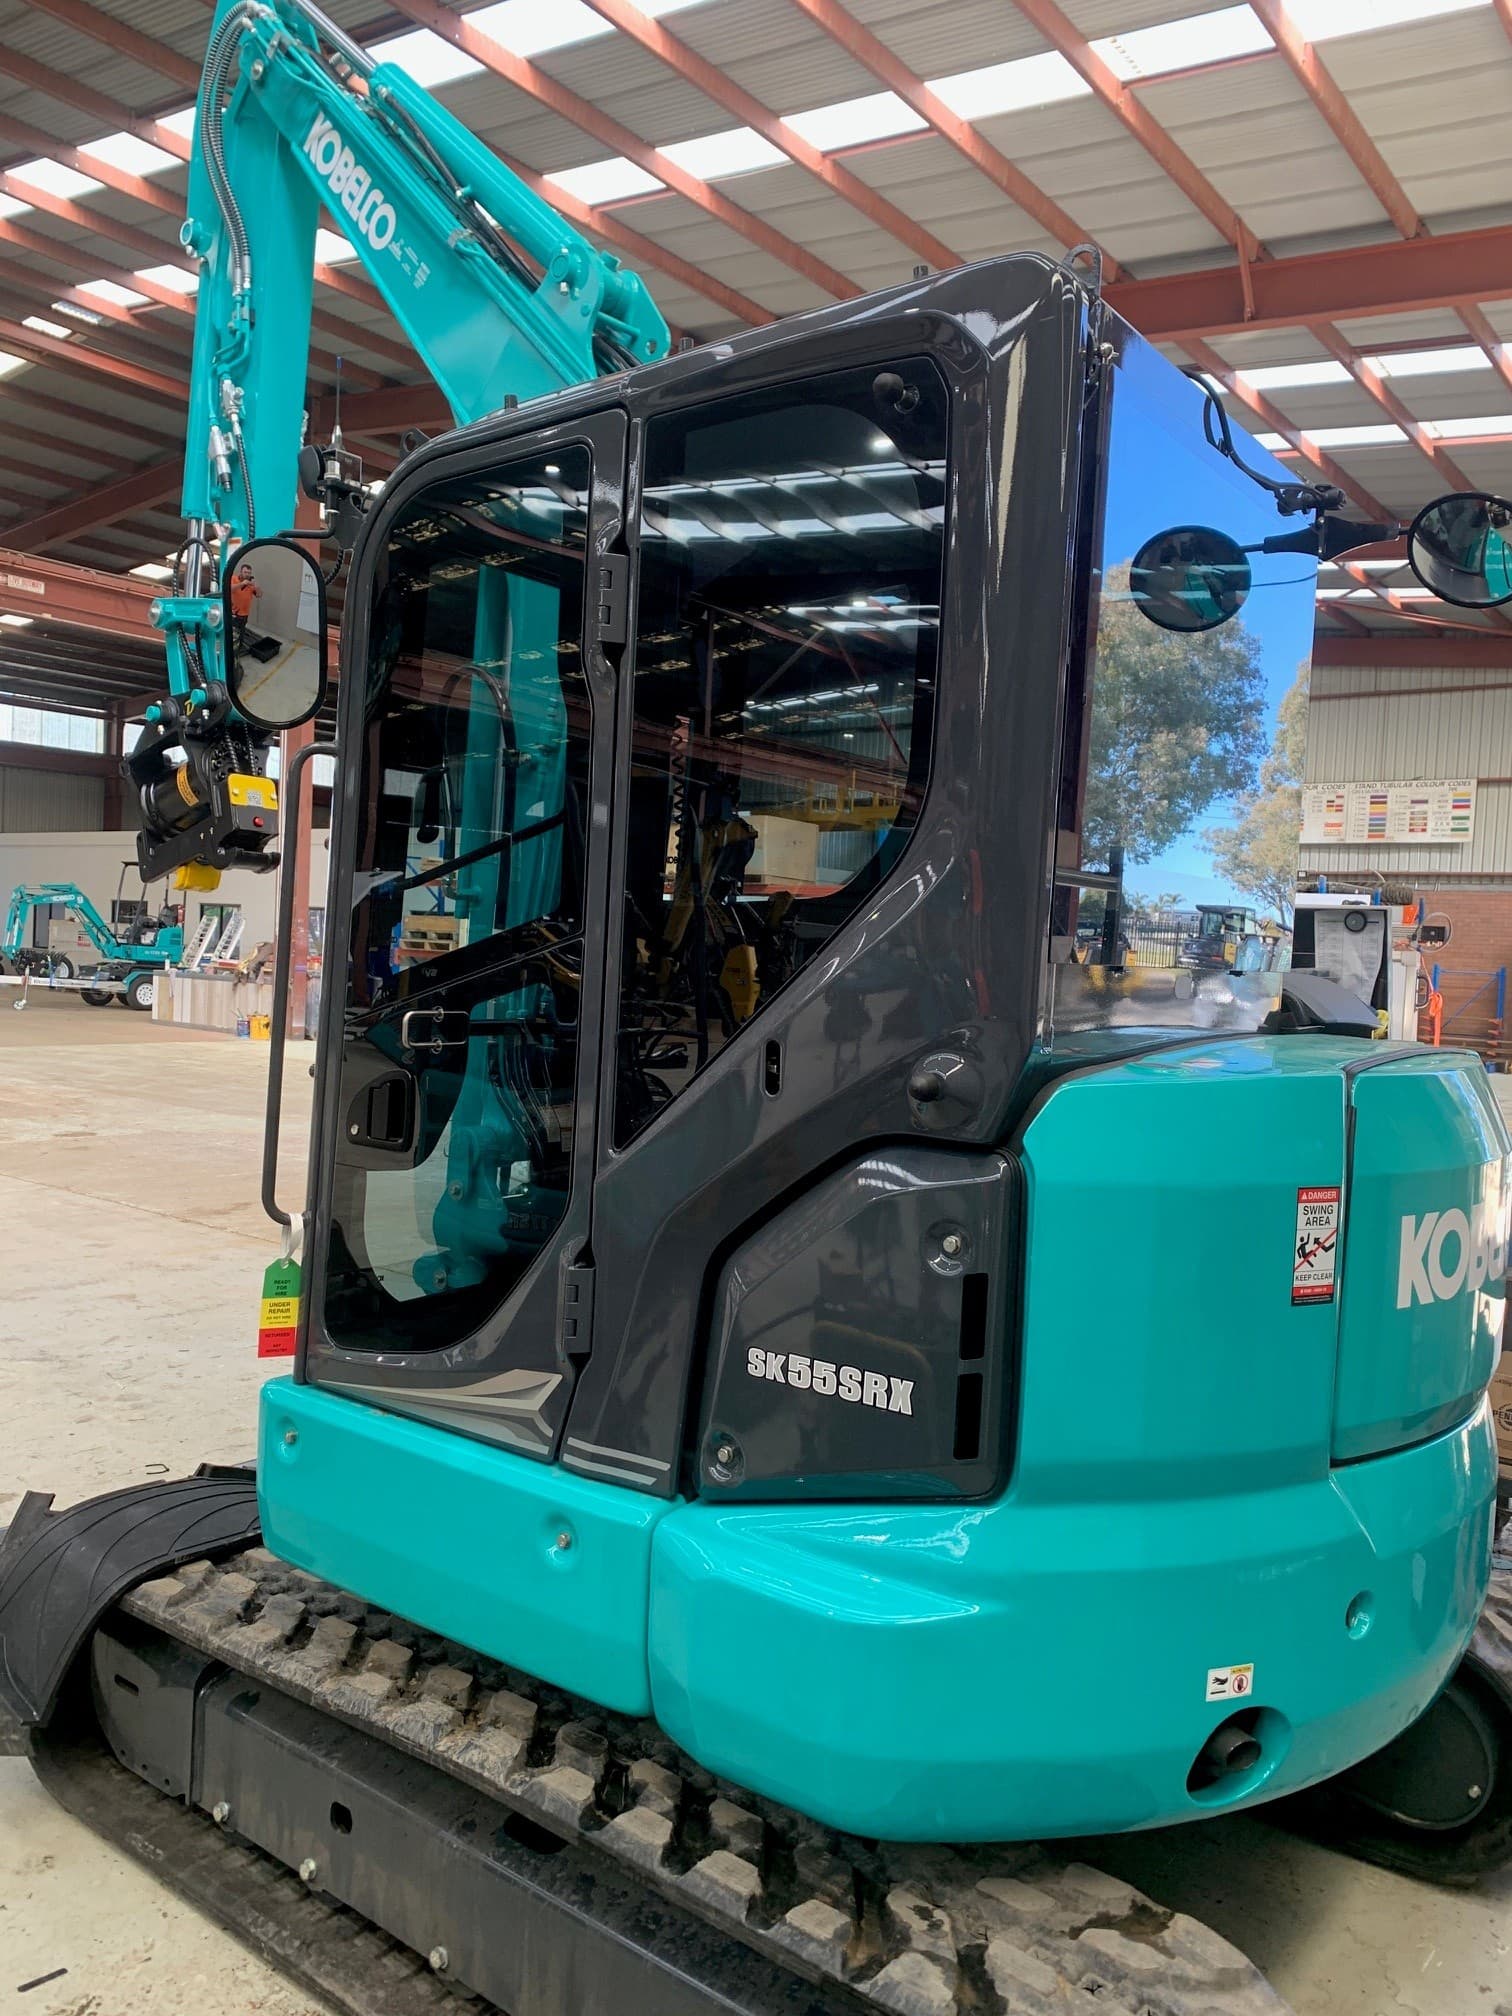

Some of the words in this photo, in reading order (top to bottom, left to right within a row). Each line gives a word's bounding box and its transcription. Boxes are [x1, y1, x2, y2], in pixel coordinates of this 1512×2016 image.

[303, 111, 396, 250] KOBELCO
[1308, 1191, 1337, 1200] DANGER
[1303, 1204, 1334, 1216] SWING
[1305, 1216, 1331, 1227] AREA
[1295, 1273, 1312, 1281] KEEP
[1313, 1272, 1333, 1281] CLEAR
[747, 1347, 914, 1416] SK55SRX
